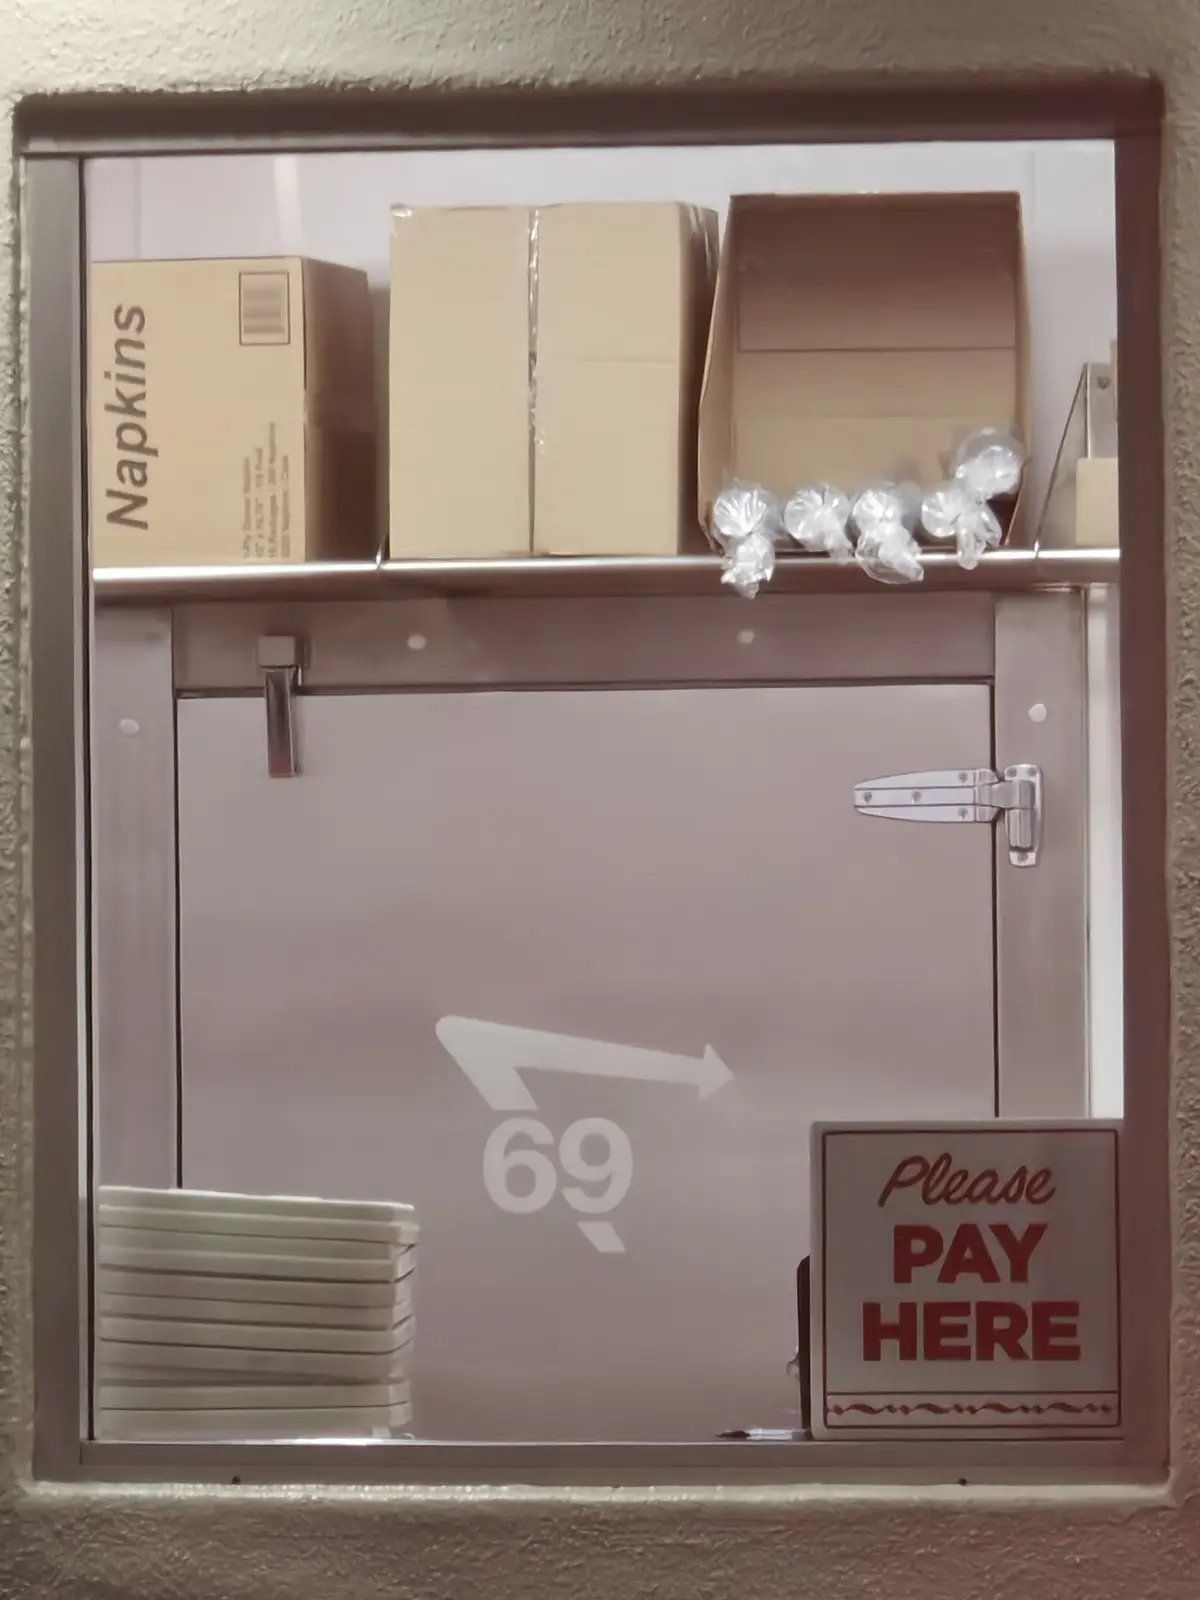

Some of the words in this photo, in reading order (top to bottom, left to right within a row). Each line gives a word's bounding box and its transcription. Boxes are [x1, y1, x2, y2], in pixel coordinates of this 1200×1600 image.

[104, 304, 159, 530] Napkins
[483, 1117, 633, 1214] 69
[877, 1152, 1056, 1208] Please
[893, 1223, 1048, 1284] PAY
[862, 1301, 1081, 1361] HERE
